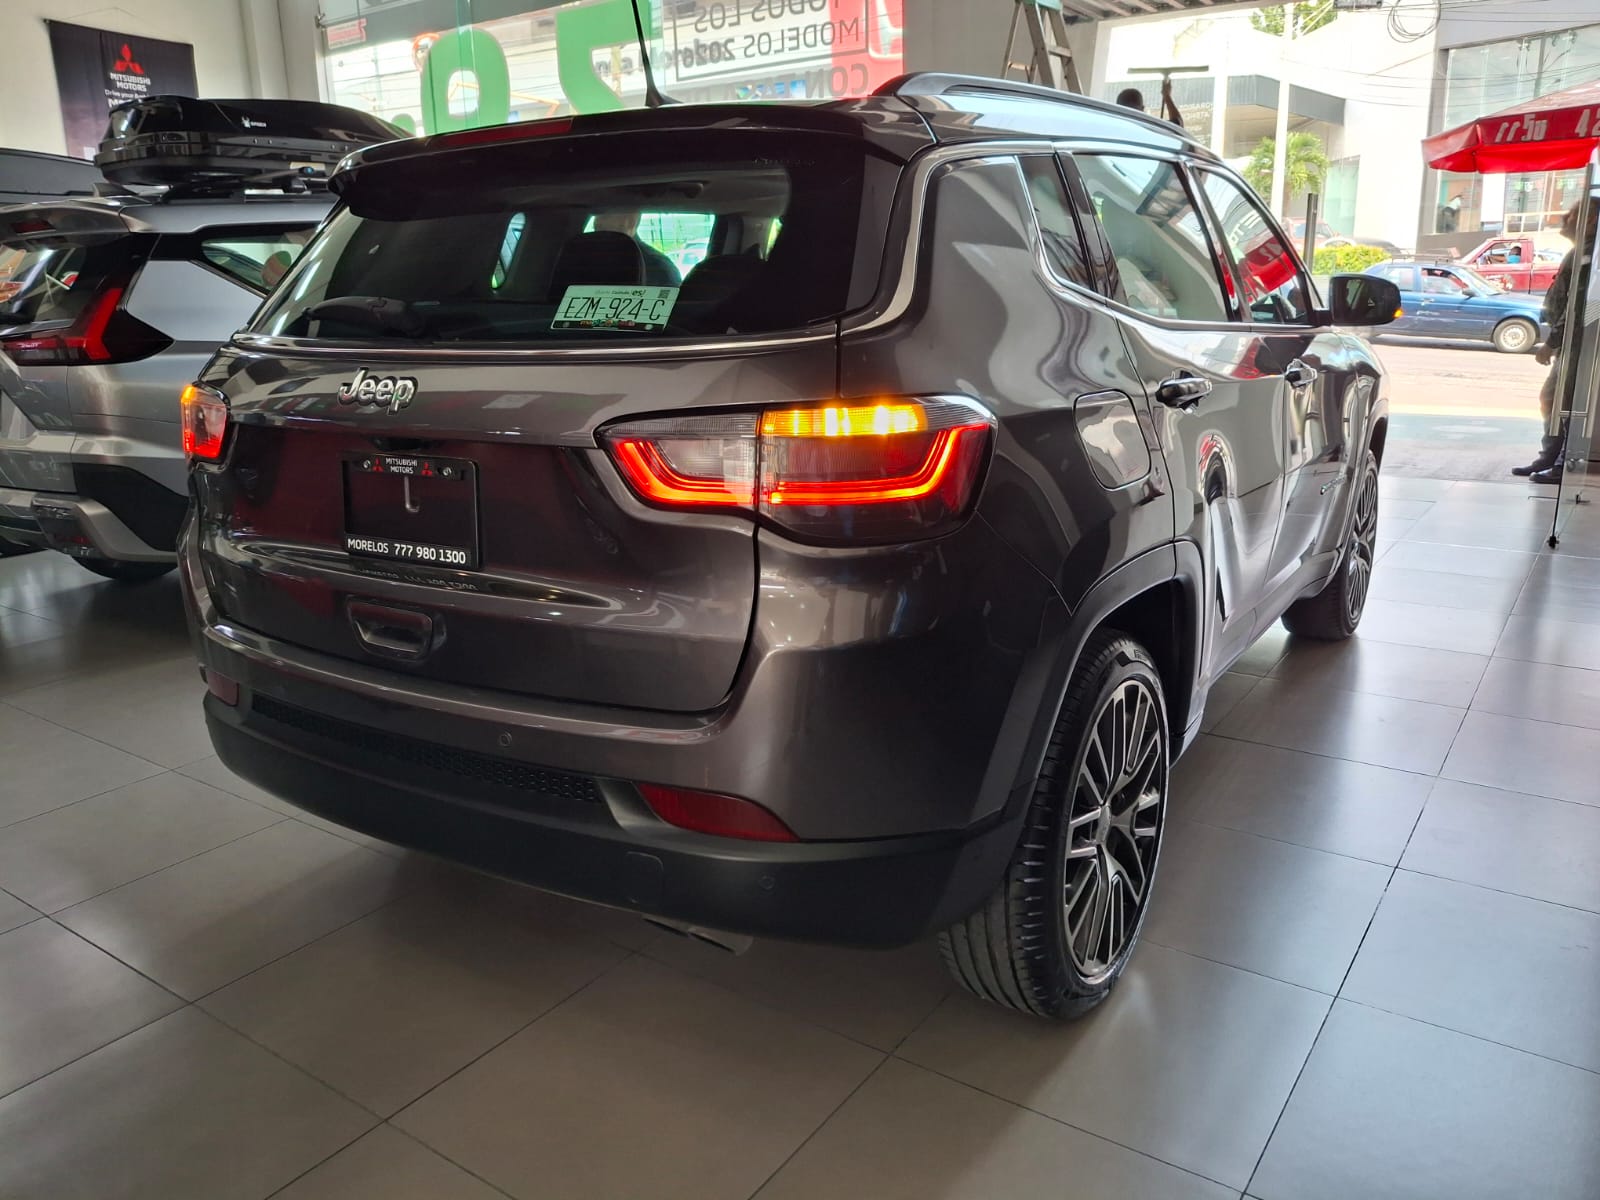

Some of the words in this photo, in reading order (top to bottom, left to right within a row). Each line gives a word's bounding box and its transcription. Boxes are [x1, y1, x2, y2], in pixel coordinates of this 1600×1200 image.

[110, 73, 151, 85] MITSUBISHI
[116, 82, 147, 91] MOTORS
[563, 297, 666, 321] EZM-924-C
[338, 367, 417, 415] Jeep
[385, 457, 418, 468] MITSUBISHI
[390, 465, 414, 474] MOTORS
[347, 538, 389, 554] MORELOS
[394, 543, 414, 558] 777
[416, 545, 437, 560] 980
[439, 548, 467, 564] 1300
